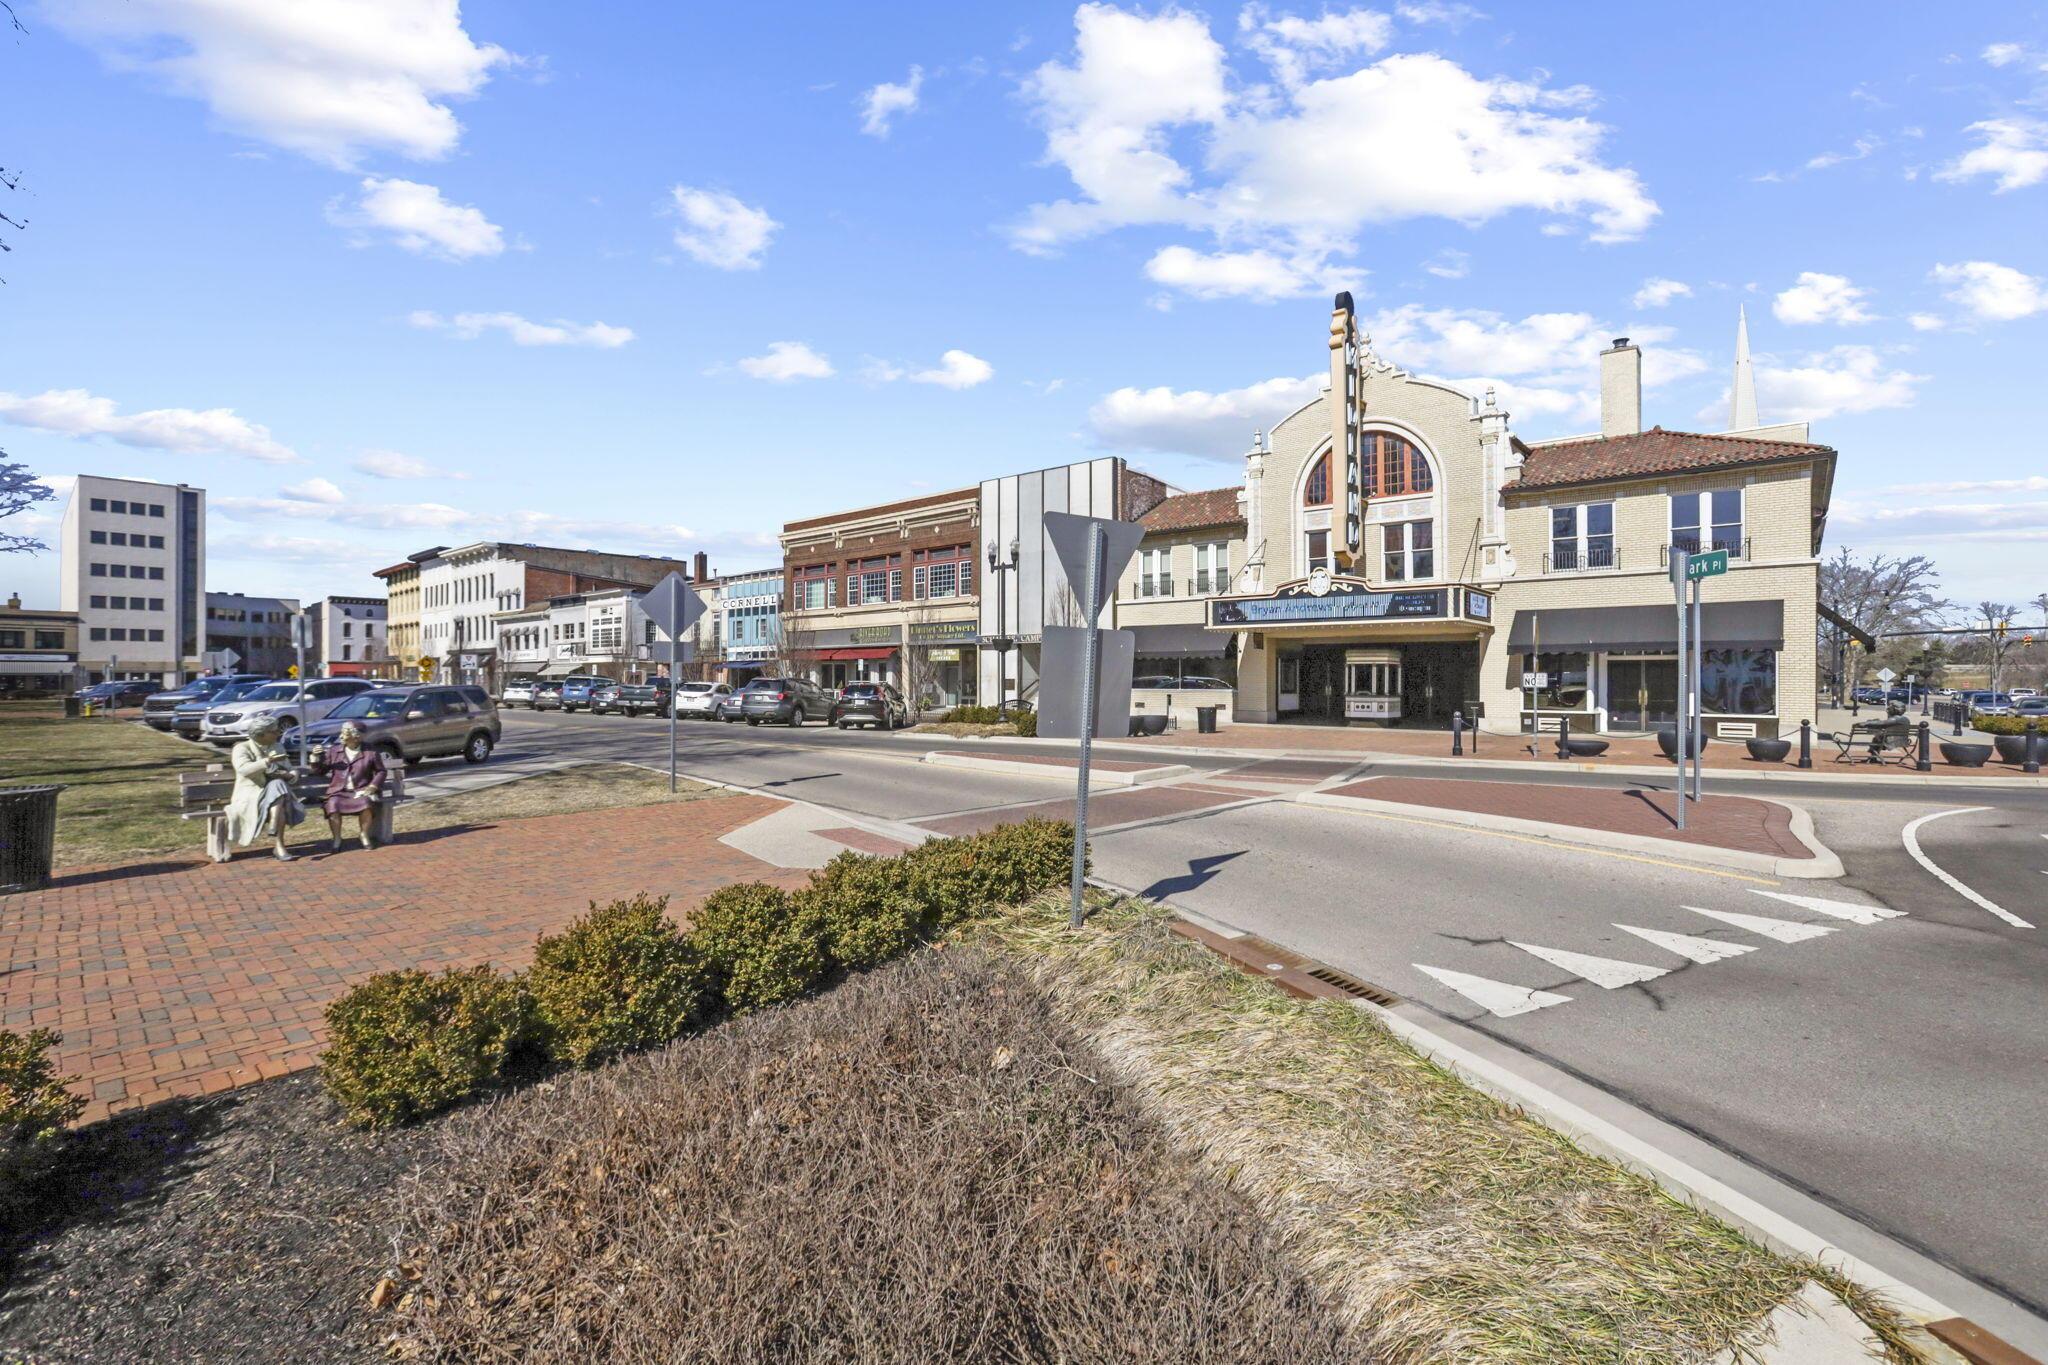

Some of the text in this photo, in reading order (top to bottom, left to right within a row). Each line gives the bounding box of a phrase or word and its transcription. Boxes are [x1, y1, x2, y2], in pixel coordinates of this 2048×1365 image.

[1689, 559, 1708, 574] ark
[722, 595, 776, 608] CORNELL
[1251, 604, 1281, 616] Bryan
[1285, 602, 1333, 613] Andrews
[1020, 634, 1041, 642] CAMP
